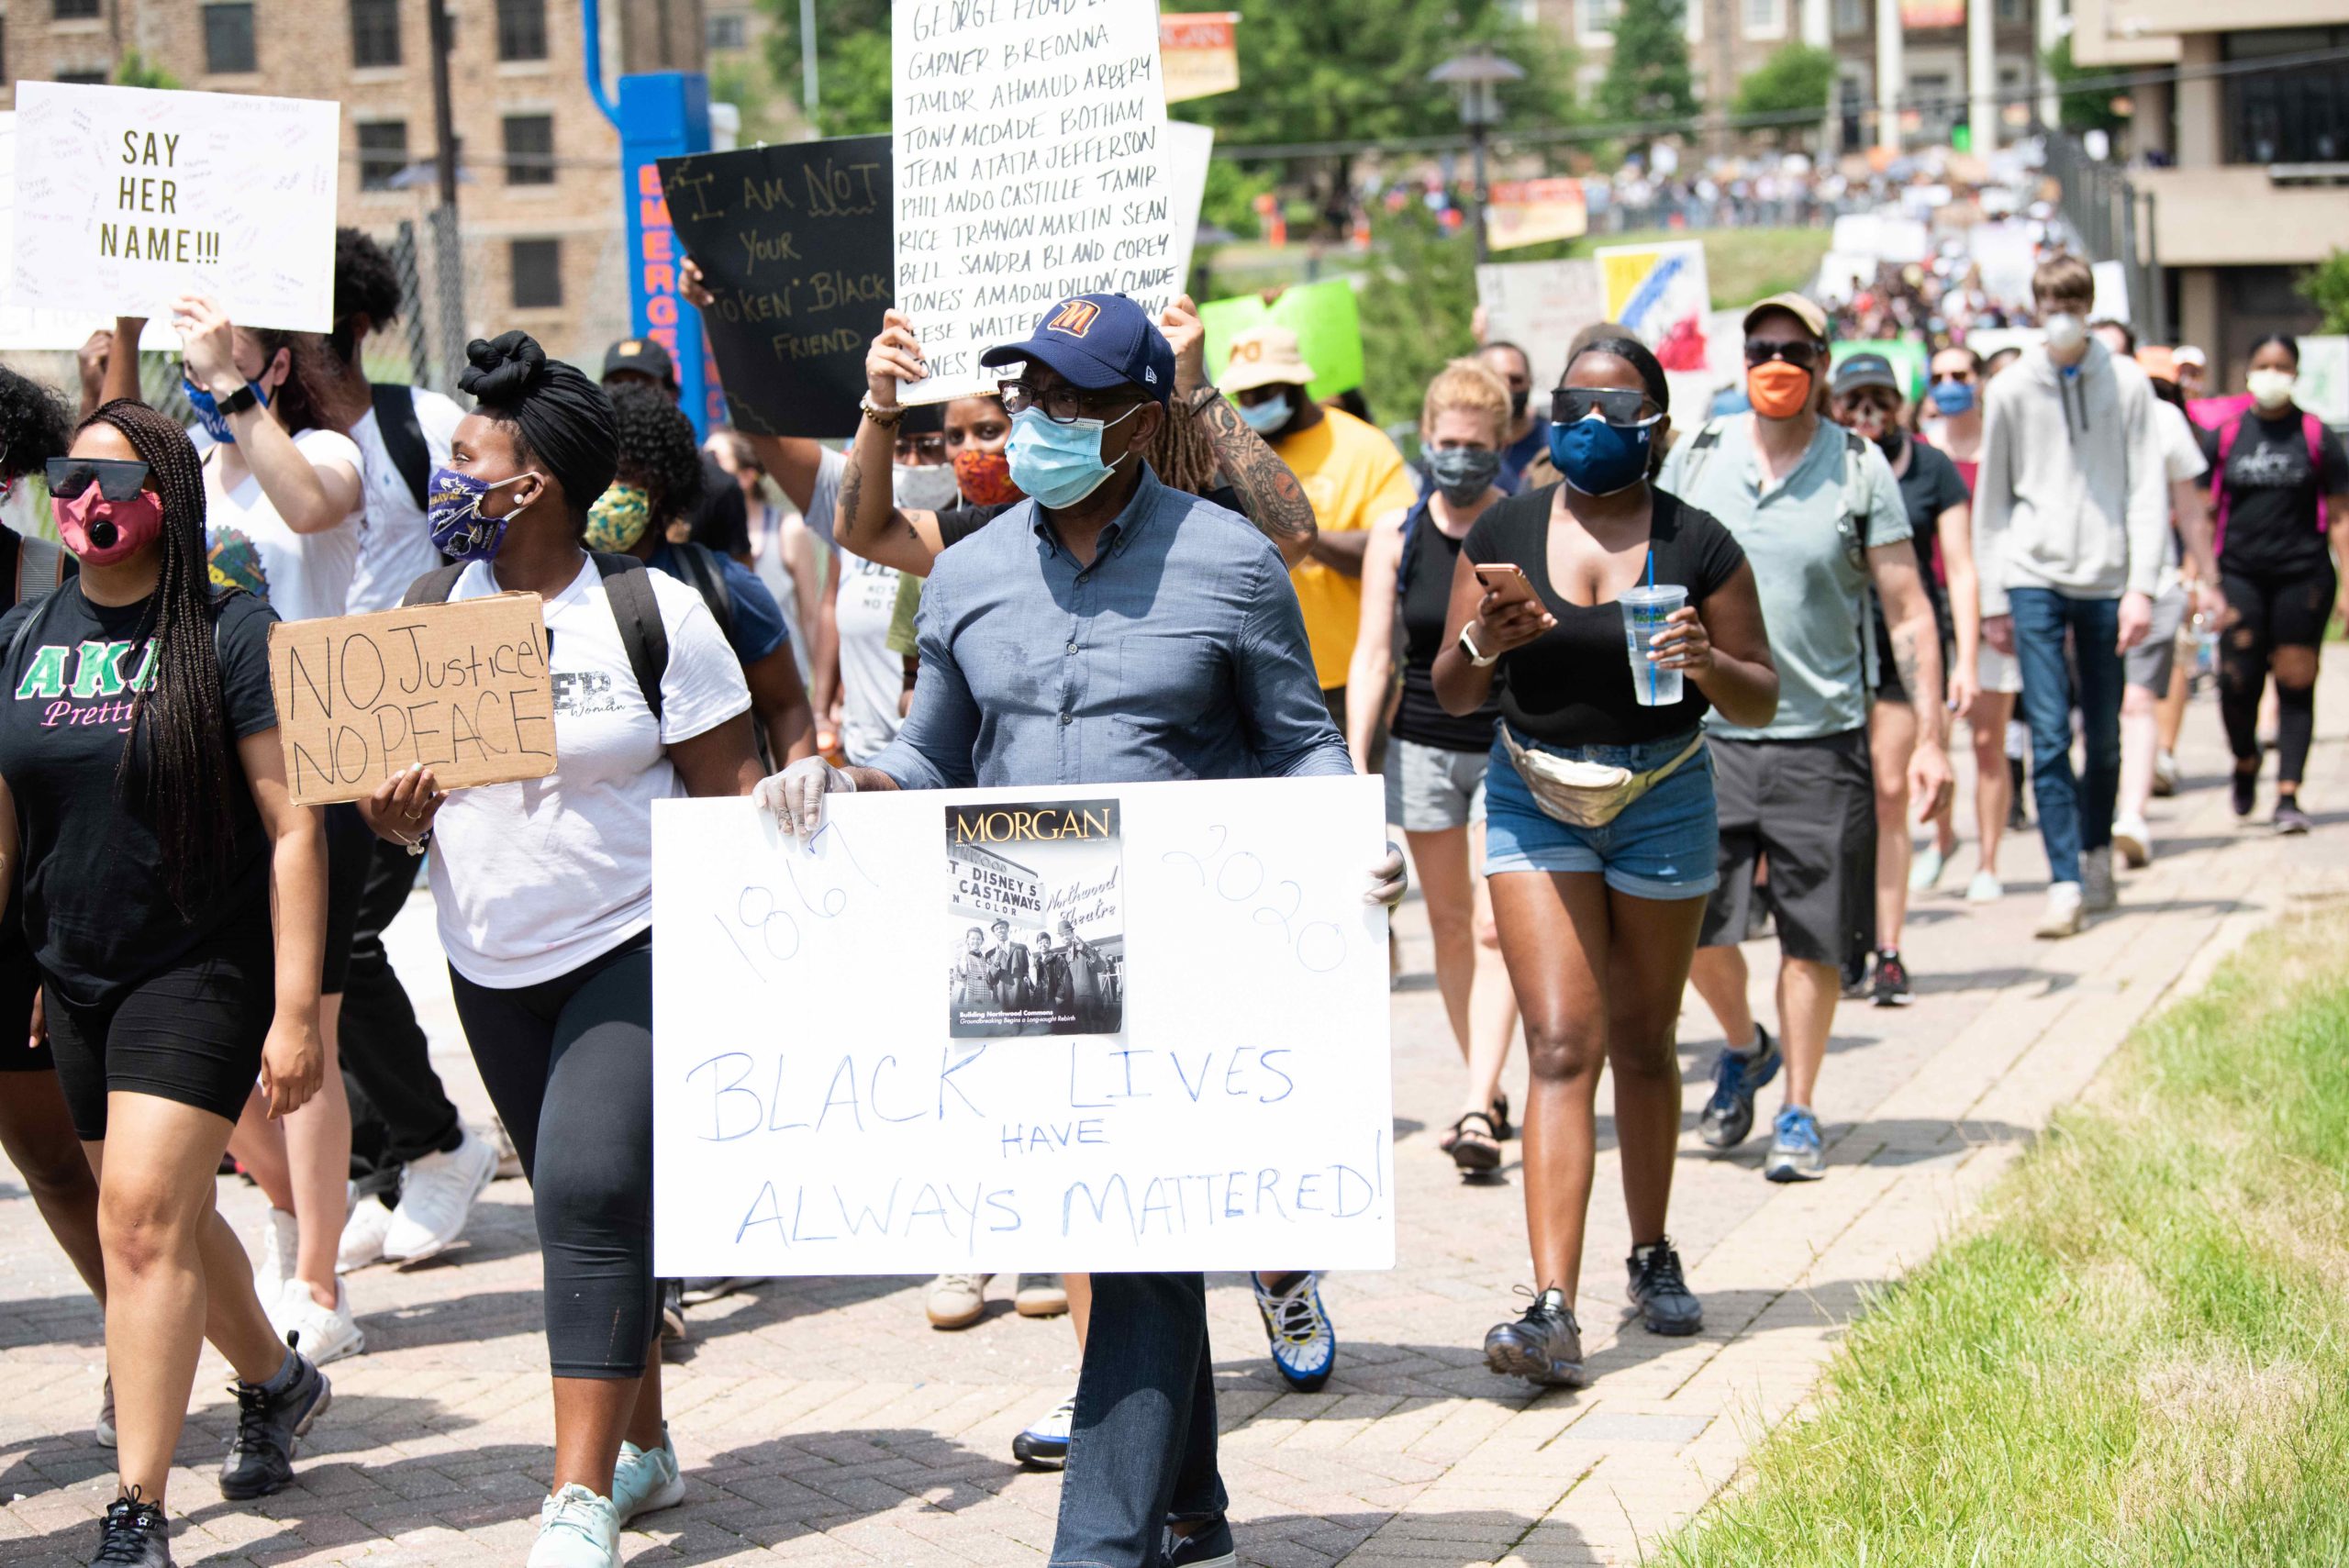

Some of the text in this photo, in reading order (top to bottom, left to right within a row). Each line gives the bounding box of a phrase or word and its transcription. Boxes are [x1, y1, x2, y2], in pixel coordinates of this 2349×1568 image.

[913, 0, 1003, 42] GEORGE
[908, 24, 1109, 81] GARNER BREONNA
[905, 53, 1152, 116] TAYLOR AHMAUD ARBERY
[903, 96, 1144, 153] TONY MCDADE BOTHAM
[122, 130, 180, 168] SAY
[902, 156, 957, 189] JEAN
[1045, 126, 1157, 170] JEFFERSON
[119, 176, 176, 214] HER
[678, 158, 880, 221] I AM NOT
[1000, 176, 1085, 208] CASTILLE
[1097, 165, 1163, 194] TAMIR
[101, 223, 219, 264] NAME!!!
[899, 229, 941, 255] RICE
[1039, 204, 1112, 236] MARTIN
[1122, 196, 1167, 227] SEAN
[899, 233, 1169, 287] BELL SANDRA BLAND COREY
[974, 281, 1052, 307] AMADOU
[1058, 268, 1118, 297] DILLON
[1121, 265, 1178, 293] CLAUDE
[911, 321, 958, 343] EESE
[1047, 300, 1100, 338] M
[291, 623, 545, 721] NO Justice!
[294, 689, 552, 795] NO PEACE
[955, 808, 1111, 843] MORGAN
[959, 880, 1041, 911] CASTAWAYS
[973, 867, 1024, 893] DISNEY
[1046, 865, 1118, 913] Northwood
[1162, 824, 1347, 973] 2020
[975, 899, 1018, 916] COLOR
[1004, 1017, 1021, 1025] Begins
[1026, 1016, 1057, 1024] Long-sought
[686, 1042, 1294, 1141] BLACK LIVES
[1001, 1118, 1110, 1158] HAVE
[736, 1129, 1383, 1257] ALWAYS MATTERED!
